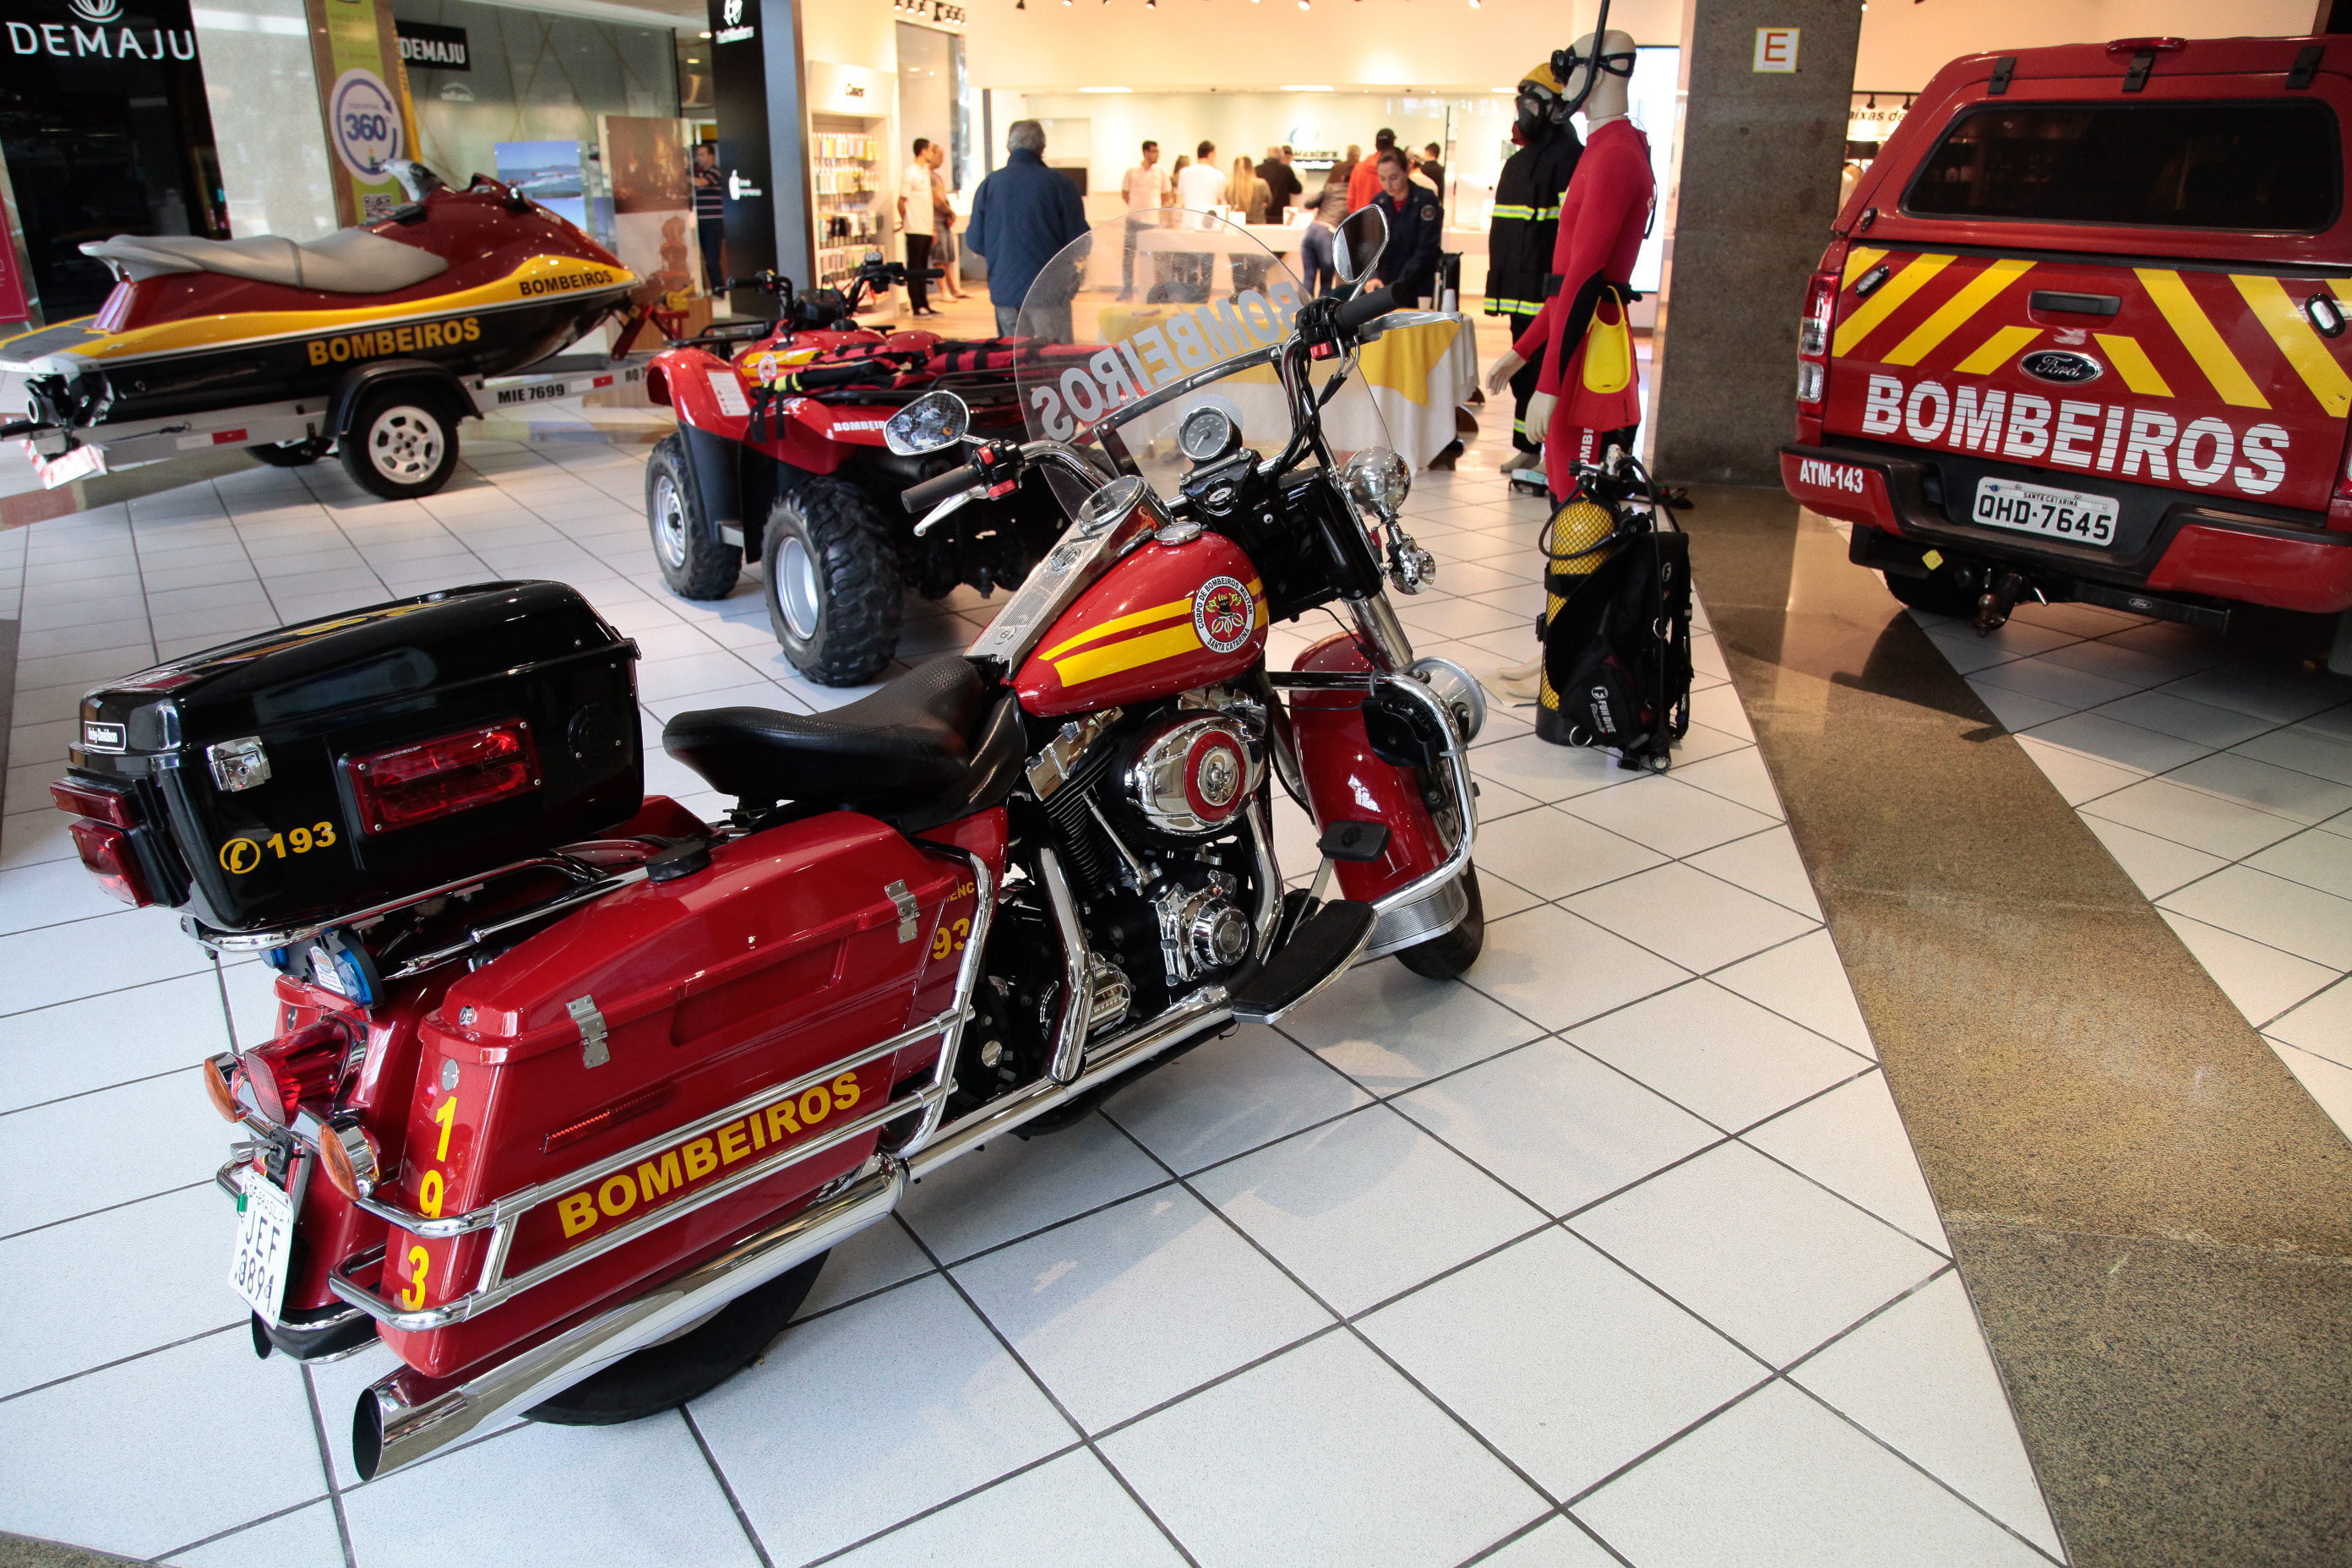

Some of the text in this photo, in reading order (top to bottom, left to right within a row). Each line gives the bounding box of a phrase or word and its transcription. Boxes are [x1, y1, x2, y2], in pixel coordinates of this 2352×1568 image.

[6, 21, 195, 60] DEMAJU
[400, 37, 466, 64] DEMAJU
[1764, 32, 1788, 62] E
[520, 270, 613, 296] BOMBEIROS
[308, 317, 481, 366] BOMBEIROS
[2035, 355, 2081, 378] Ford
[498, 384, 565, 404] MIE 7699
[1862, 373, 2290, 495] BOMBEIROS
[1799, 459, 1864, 494] ATM-143
[2023, 492, 2078, 508] SANTA CATARINA
[1195, 577, 1253, 629] CORPO DE BOMBEIROS MILITAR
[1207, 628, 1250, 651] SANTA CATARINA
[266, 821, 336, 859] 193
[557, 1072, 861, 1239] BOMBEIROS
[246, 1210, 280, 1264] JEF
